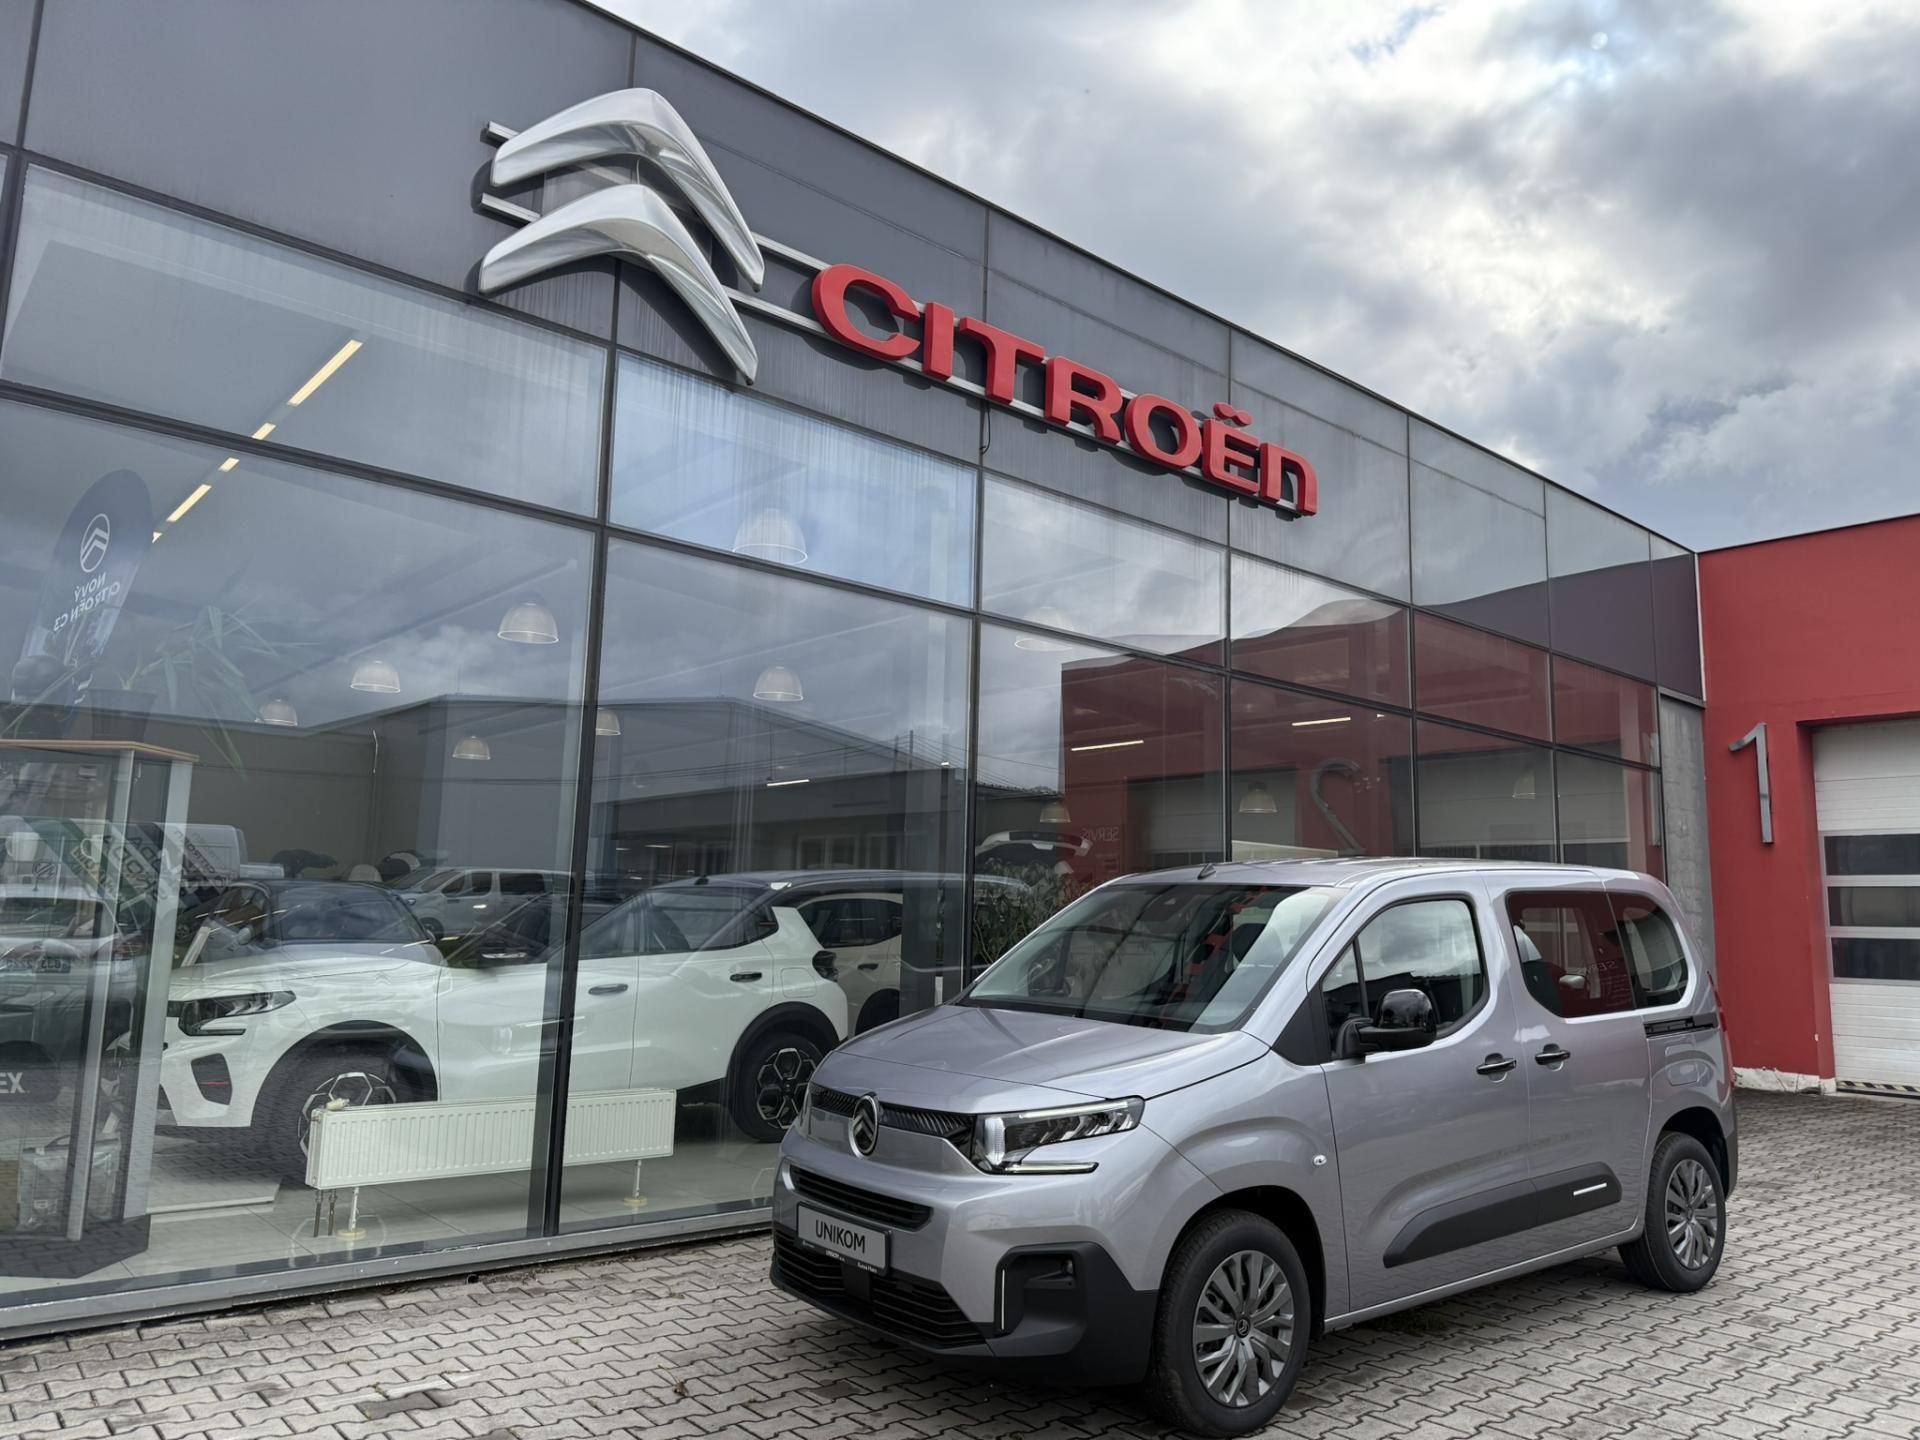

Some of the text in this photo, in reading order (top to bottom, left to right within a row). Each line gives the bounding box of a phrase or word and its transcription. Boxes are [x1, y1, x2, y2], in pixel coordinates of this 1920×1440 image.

[811, 263, 1318, 516] CITROËN
[1728, 722, 1774, 845] 1
[815, 1219, 865, 1253] UNIKOM
